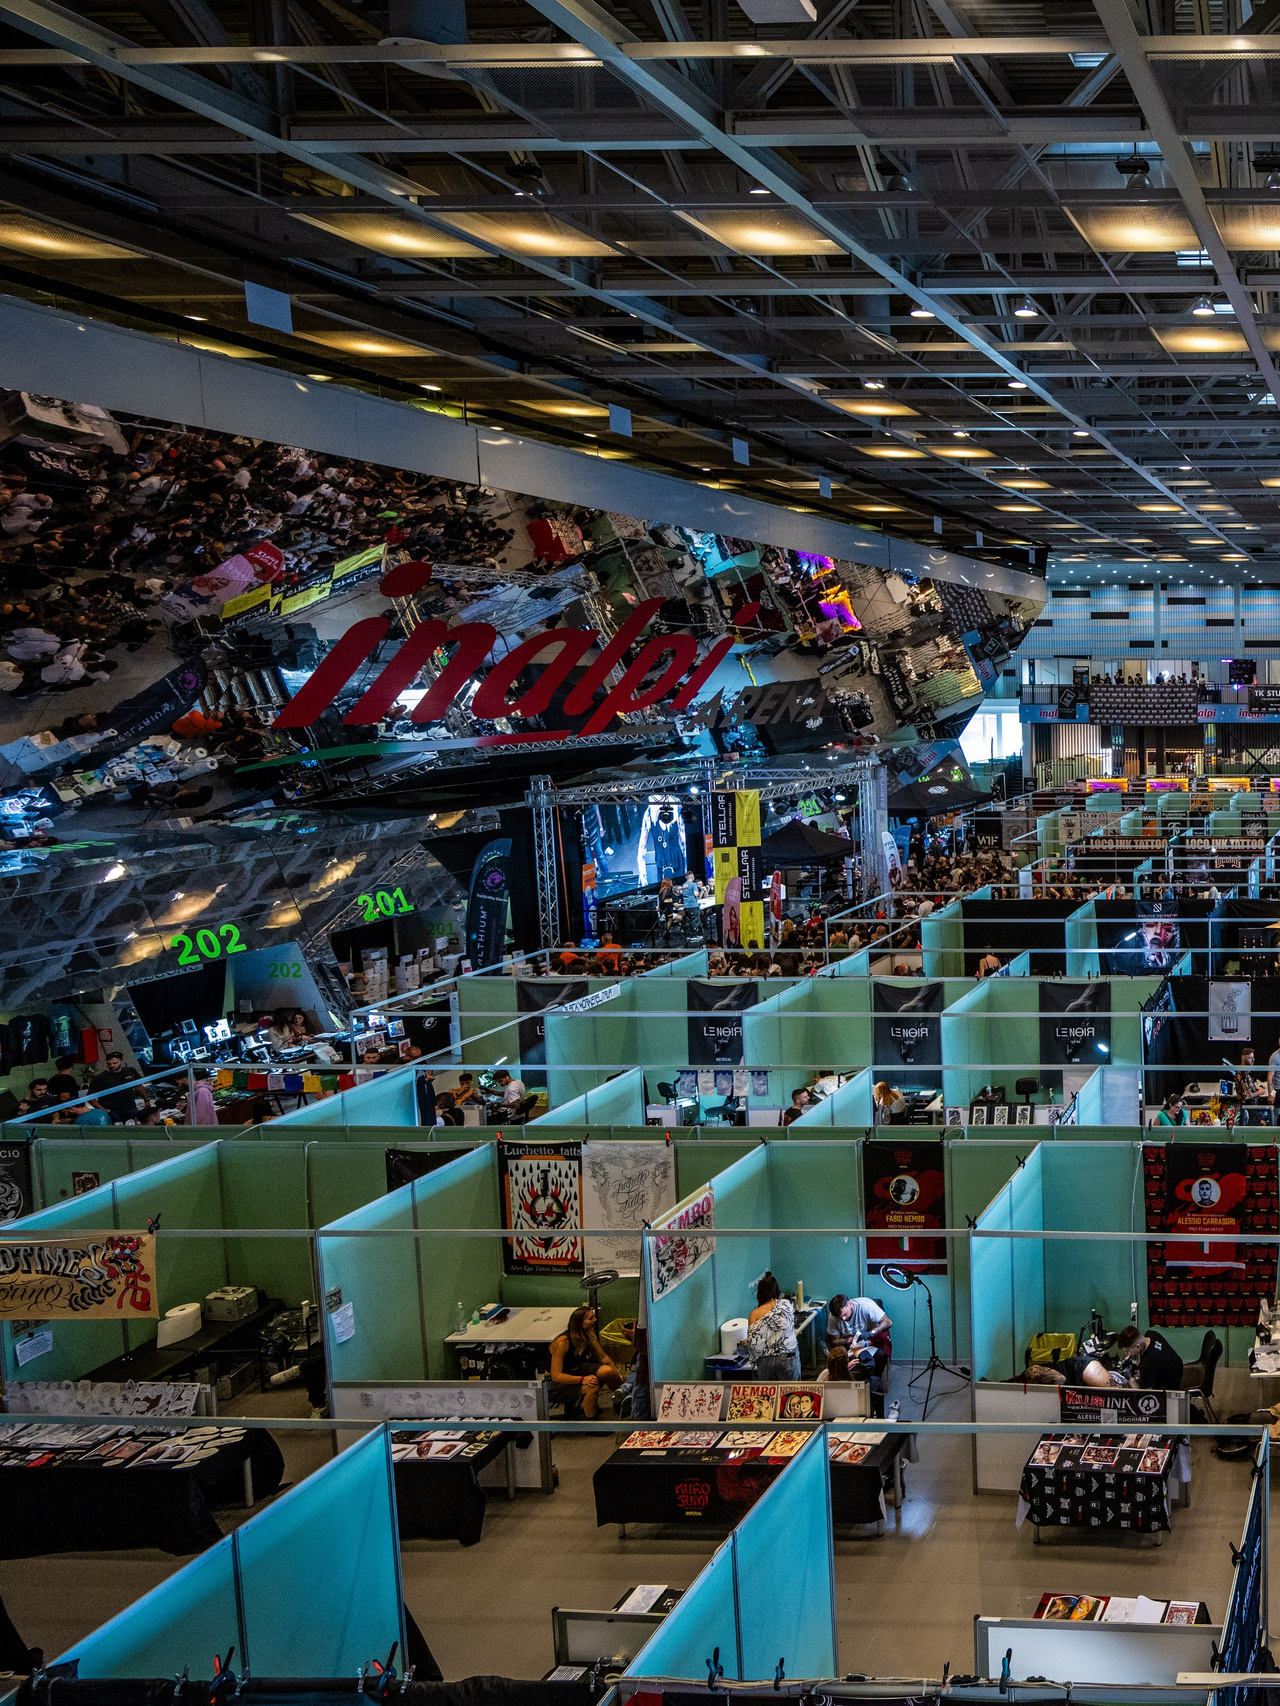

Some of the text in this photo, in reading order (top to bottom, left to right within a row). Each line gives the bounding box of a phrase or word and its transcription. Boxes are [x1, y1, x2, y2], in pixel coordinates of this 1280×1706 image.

[273, 561, 760, 737] inalpi
[1039, 708, 1058, 718] inal
[1198, 708, 1217, 719] alpi
[717, 794, 727, 845] STELLAR
[741, 849, 750, 899] STELLAR
[356, 887, 415, 922] 201
[170, 923, 247, 966] 202
[477, 911, 488, 968] ALTHIUM
[268, 962, 303, 979] 202
[885, 1214, 925, 1223] FABIO NEMBO
[1177, 1217, 1202, 1225] ALESSIO
[731, 1385, 777, 1398] NEMBO
[1065, 1389, 1138, 1416] KILLER INK
[675, 1482, 711, 1495] KURO
[677, 1494, 709, 1507] SUMI
